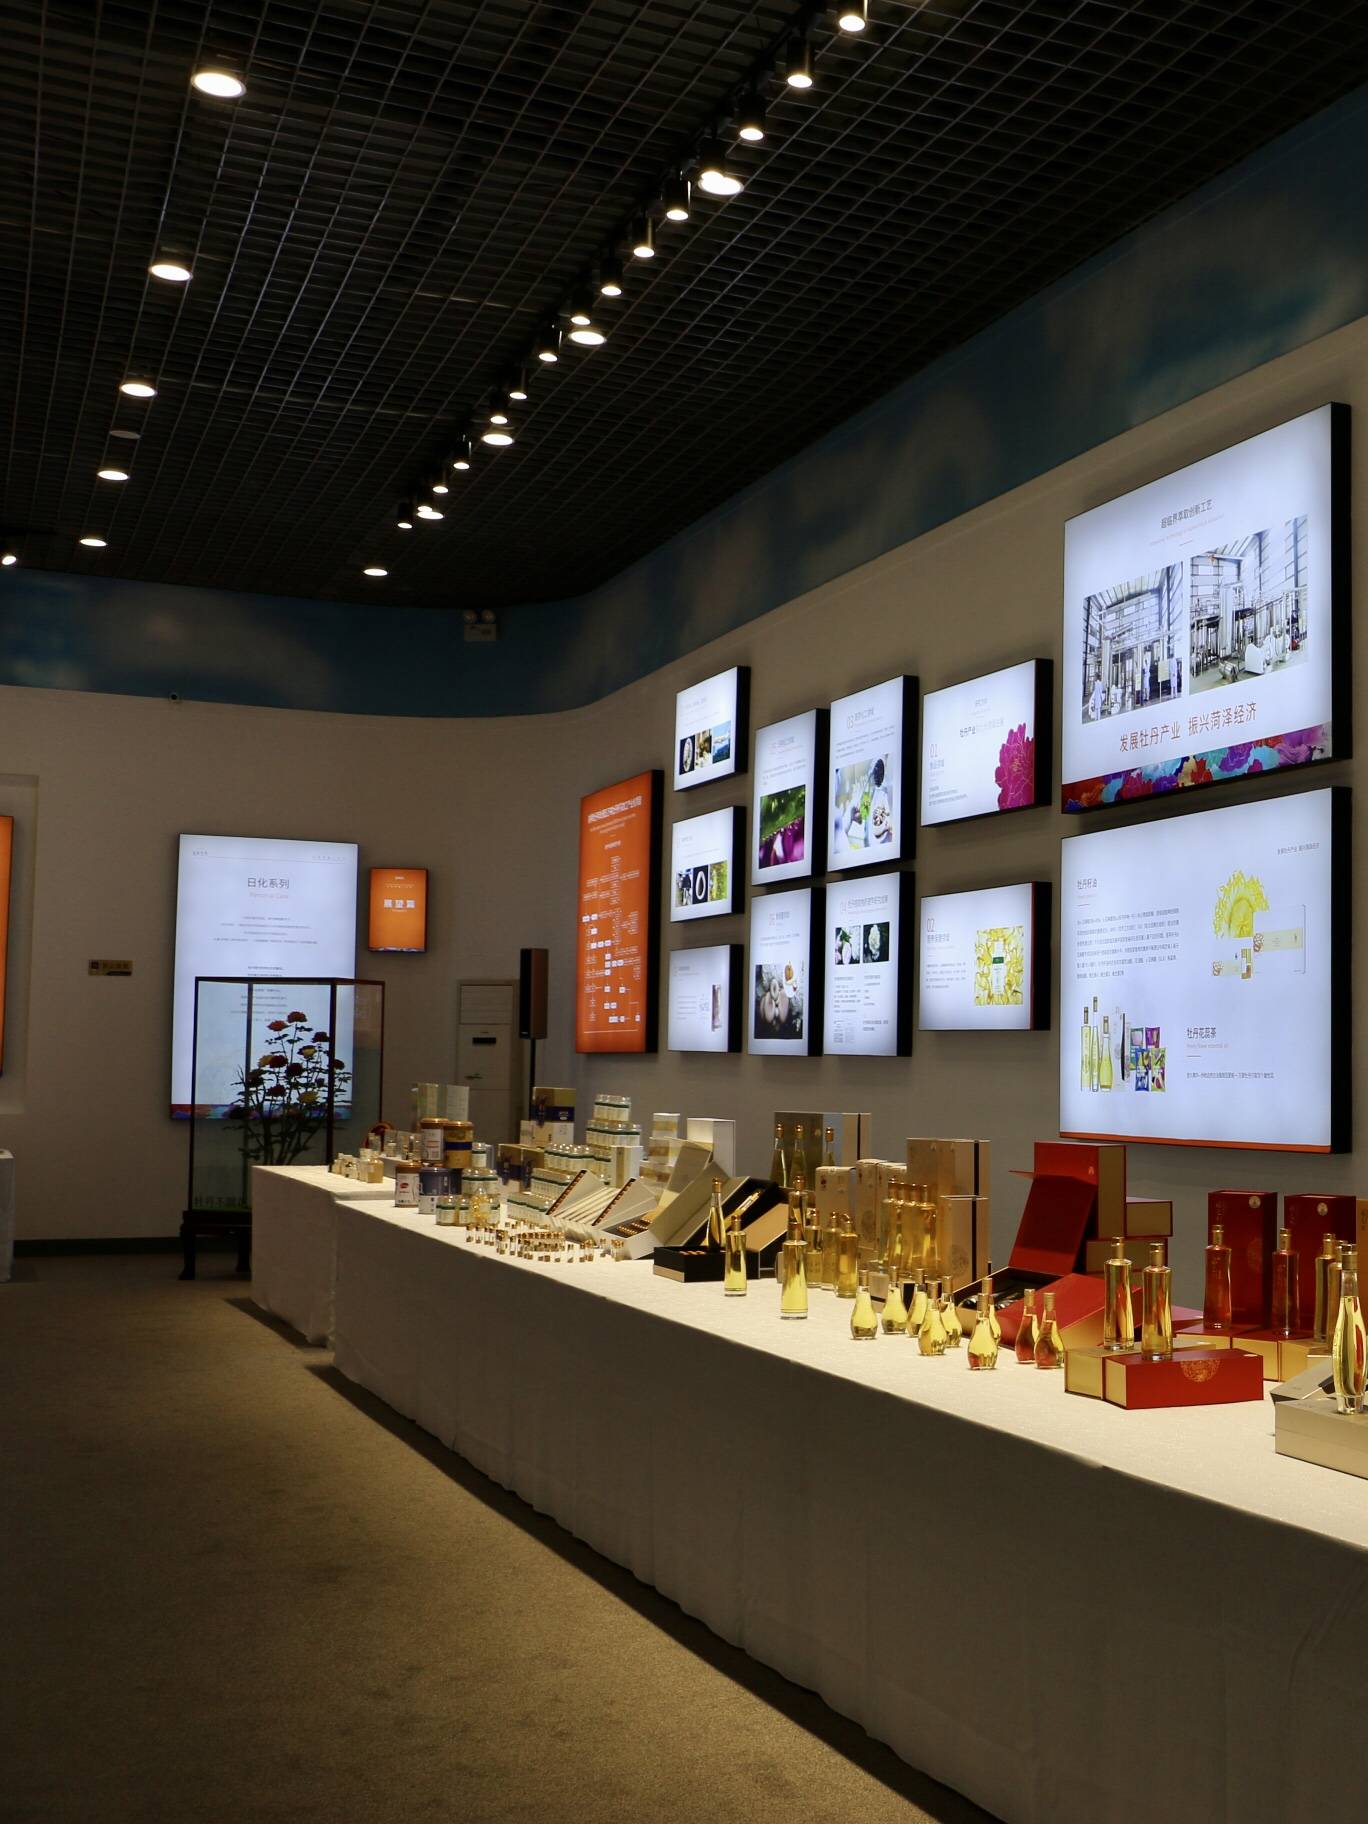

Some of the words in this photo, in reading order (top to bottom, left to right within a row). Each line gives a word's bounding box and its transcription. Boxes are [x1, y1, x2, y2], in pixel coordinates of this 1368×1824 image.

[1119, 721, 1181, 752] 发展牡丹产业
[1188, 702, 1257, 736] 振兴菏泽经济
[248, 877, 290, 889] 日化系列
